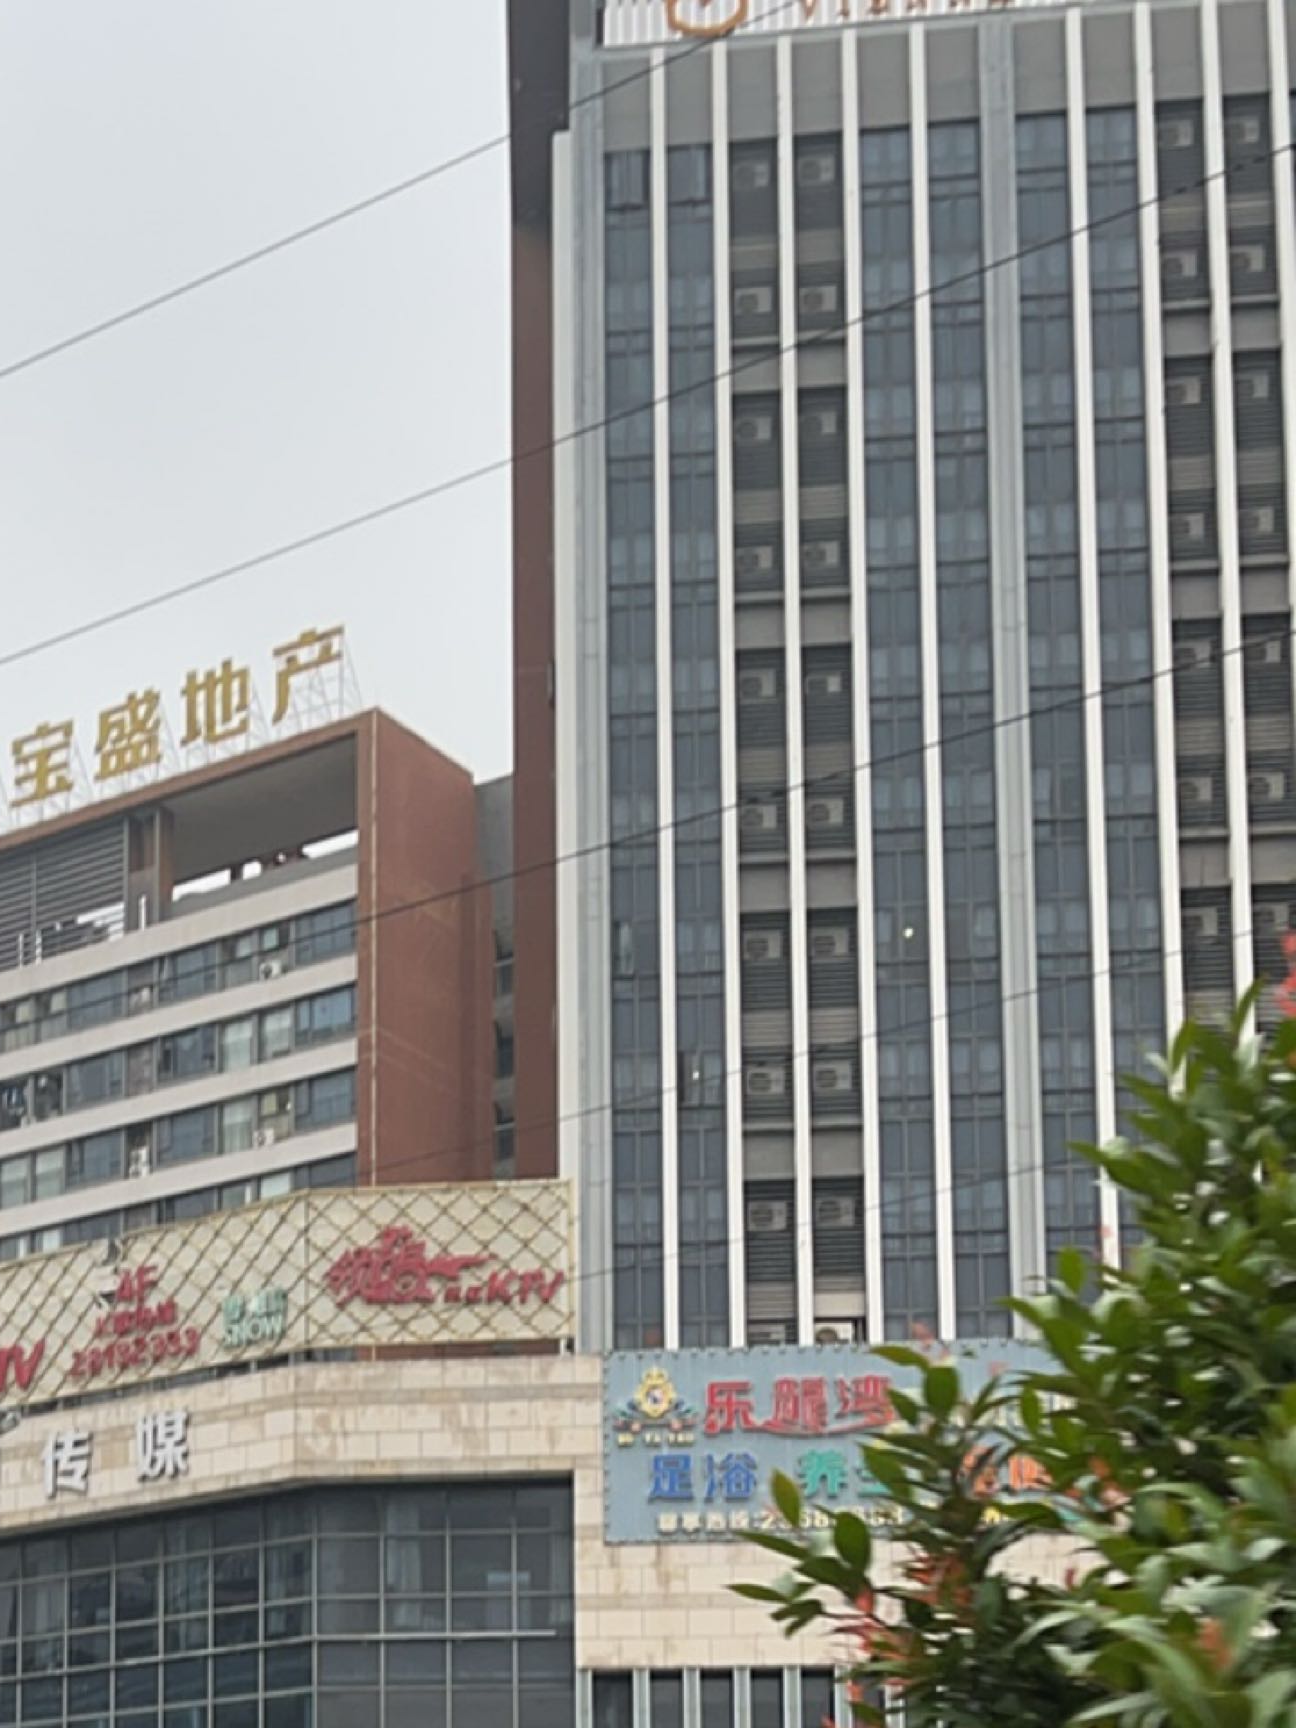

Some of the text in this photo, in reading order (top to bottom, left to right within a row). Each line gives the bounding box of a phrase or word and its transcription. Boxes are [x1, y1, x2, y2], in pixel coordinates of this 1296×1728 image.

[10, 624, 345, 808] 宝盛地产
[488, 1269, 564, 1305] KTV
[223, 1314, 287, 1349] SNOW
[648, 1453, 759, 1502] 足浴
